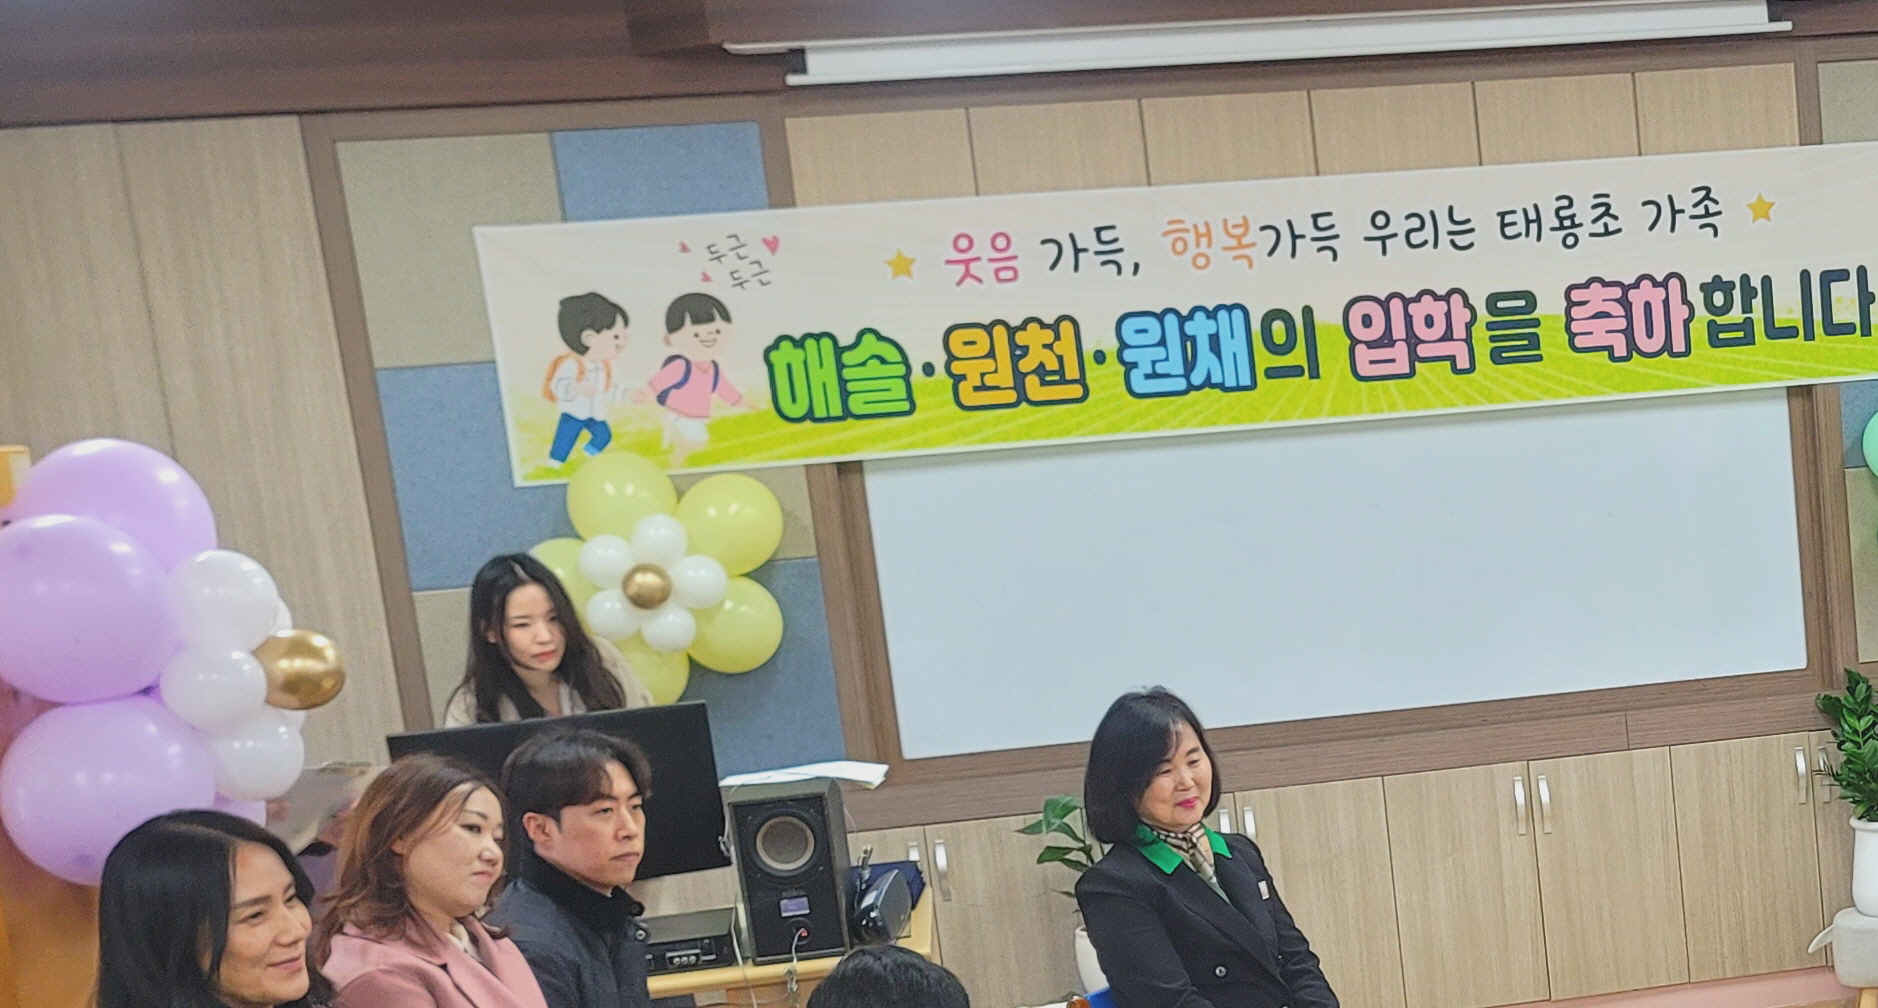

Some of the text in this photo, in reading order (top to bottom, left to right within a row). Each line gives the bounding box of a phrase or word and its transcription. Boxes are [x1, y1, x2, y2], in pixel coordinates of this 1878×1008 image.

[706, 234, 749, 264] 두근
[944, 231, 1020, 286] 웃음
[1039, 224, 1142, 277] 가득,
[1364, 204, 1477, 256] 우리는
[1496, 193, 1622, 250] 태룡초
[1641, 185, 1723, 239] 가족
[729, 260, 772, 290] 두근
[1343, 286, 1543, 381] 입학을
